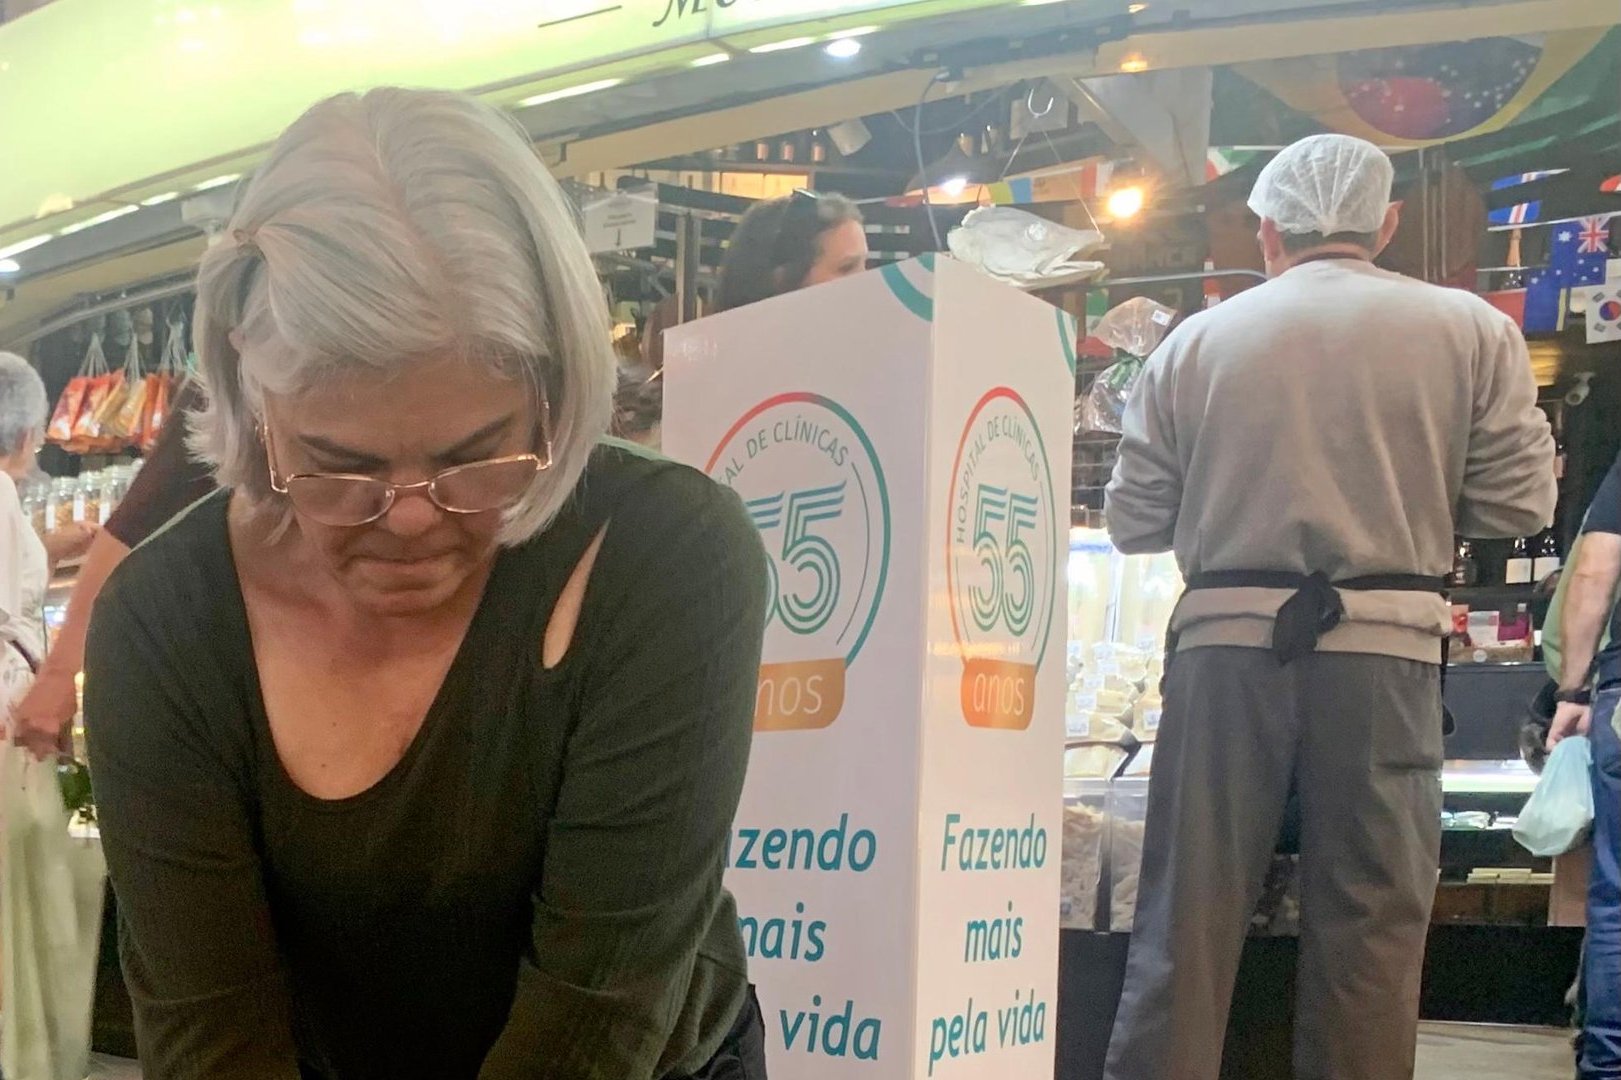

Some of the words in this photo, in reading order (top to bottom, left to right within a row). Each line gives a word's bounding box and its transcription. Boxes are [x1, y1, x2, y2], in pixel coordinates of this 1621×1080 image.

[746, 428, 769, 460] DE
[773, 414, 849, 468] CLÍNICAS
[955, 434, 986, 544] HOSPITAL
[987, 417, 1001, 442] DE
[1001, 414, 1041, 483] CLÍNICAS
[967, 483, 1039, 638] 55
[755, 673, 823, 719] nos
[973, 672, 1025, 717] anos
[725, 813, 877, 872] zendo
[940, 812, 1047, 873] Fazendo
[964, 900, 1023, 963] mais
[780, 994, 882, 1061] vida
[928, 997, 988, 1077] pela
[997, 988, 1047, 1049] vida
